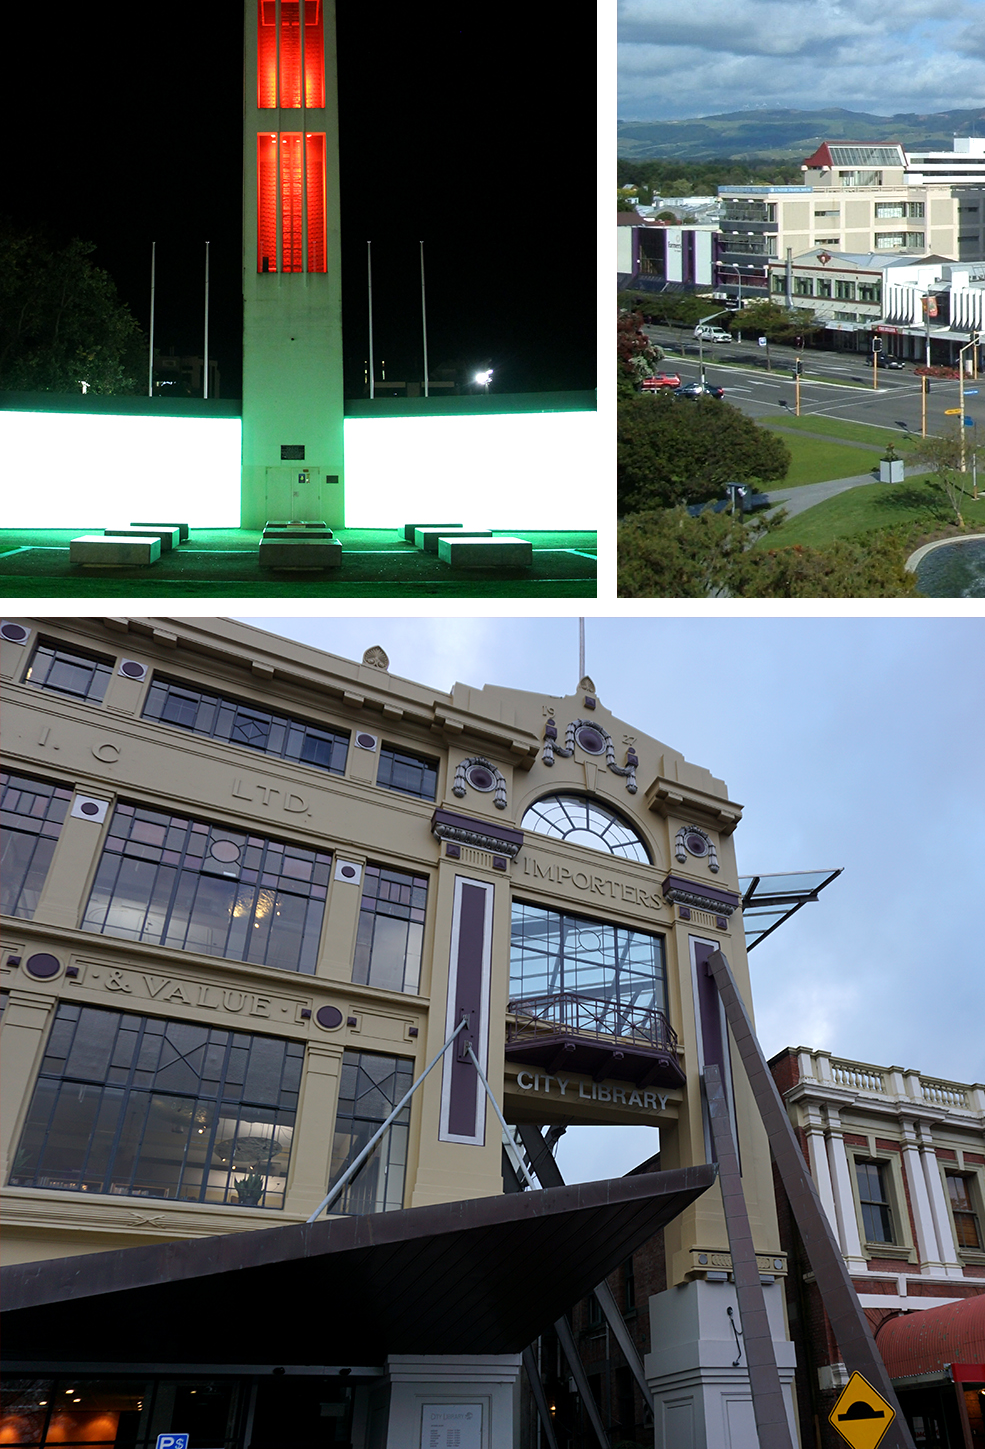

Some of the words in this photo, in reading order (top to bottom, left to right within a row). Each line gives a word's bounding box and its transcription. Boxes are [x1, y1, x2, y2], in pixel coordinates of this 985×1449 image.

[542, 706, 556, 717] 19
[91, 743, 121, 764] C
[523, 856, 663, 911] IMPORTERS
[104, 970, 132, 994] &
[142, 974, 272, 1019] VALUE
[517, 1070, 570, 1096] CITY
[578, 1080, 670, 1111] LIBRARY
[160, 1437, 175, 1449] P
